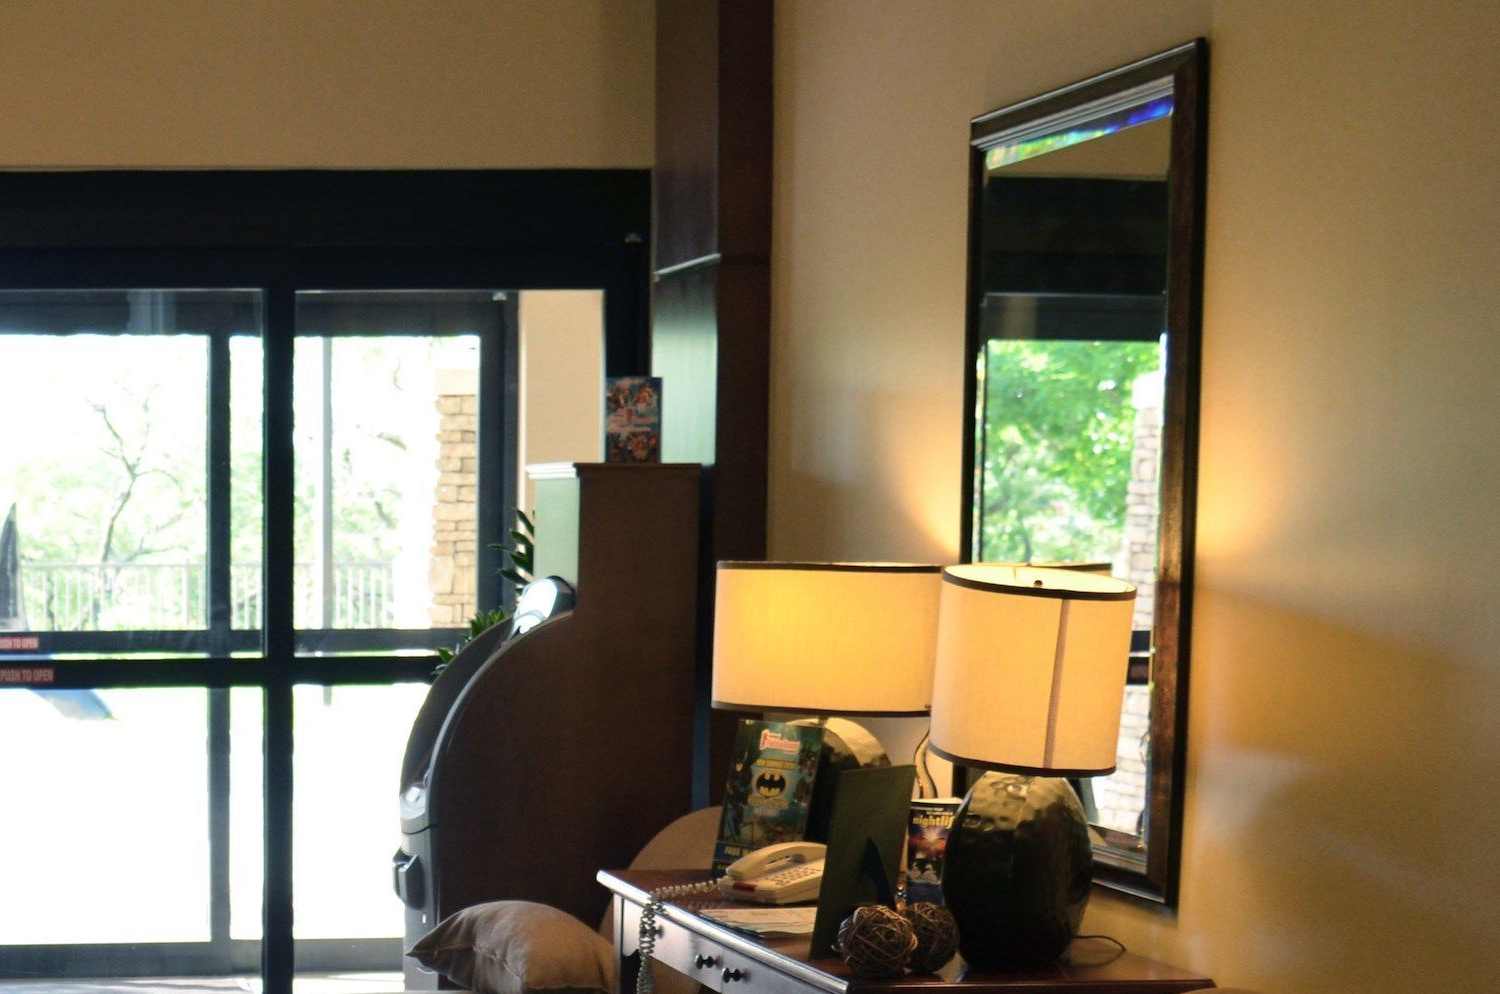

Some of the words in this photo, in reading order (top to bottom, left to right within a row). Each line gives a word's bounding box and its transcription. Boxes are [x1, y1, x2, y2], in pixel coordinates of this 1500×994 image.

[0, 670, 20, 683] PUSH
[22, 670, 32, 683] TO
[34, 670, 53, 683] OPEN
[912, 815, 955, 829] nightlif
